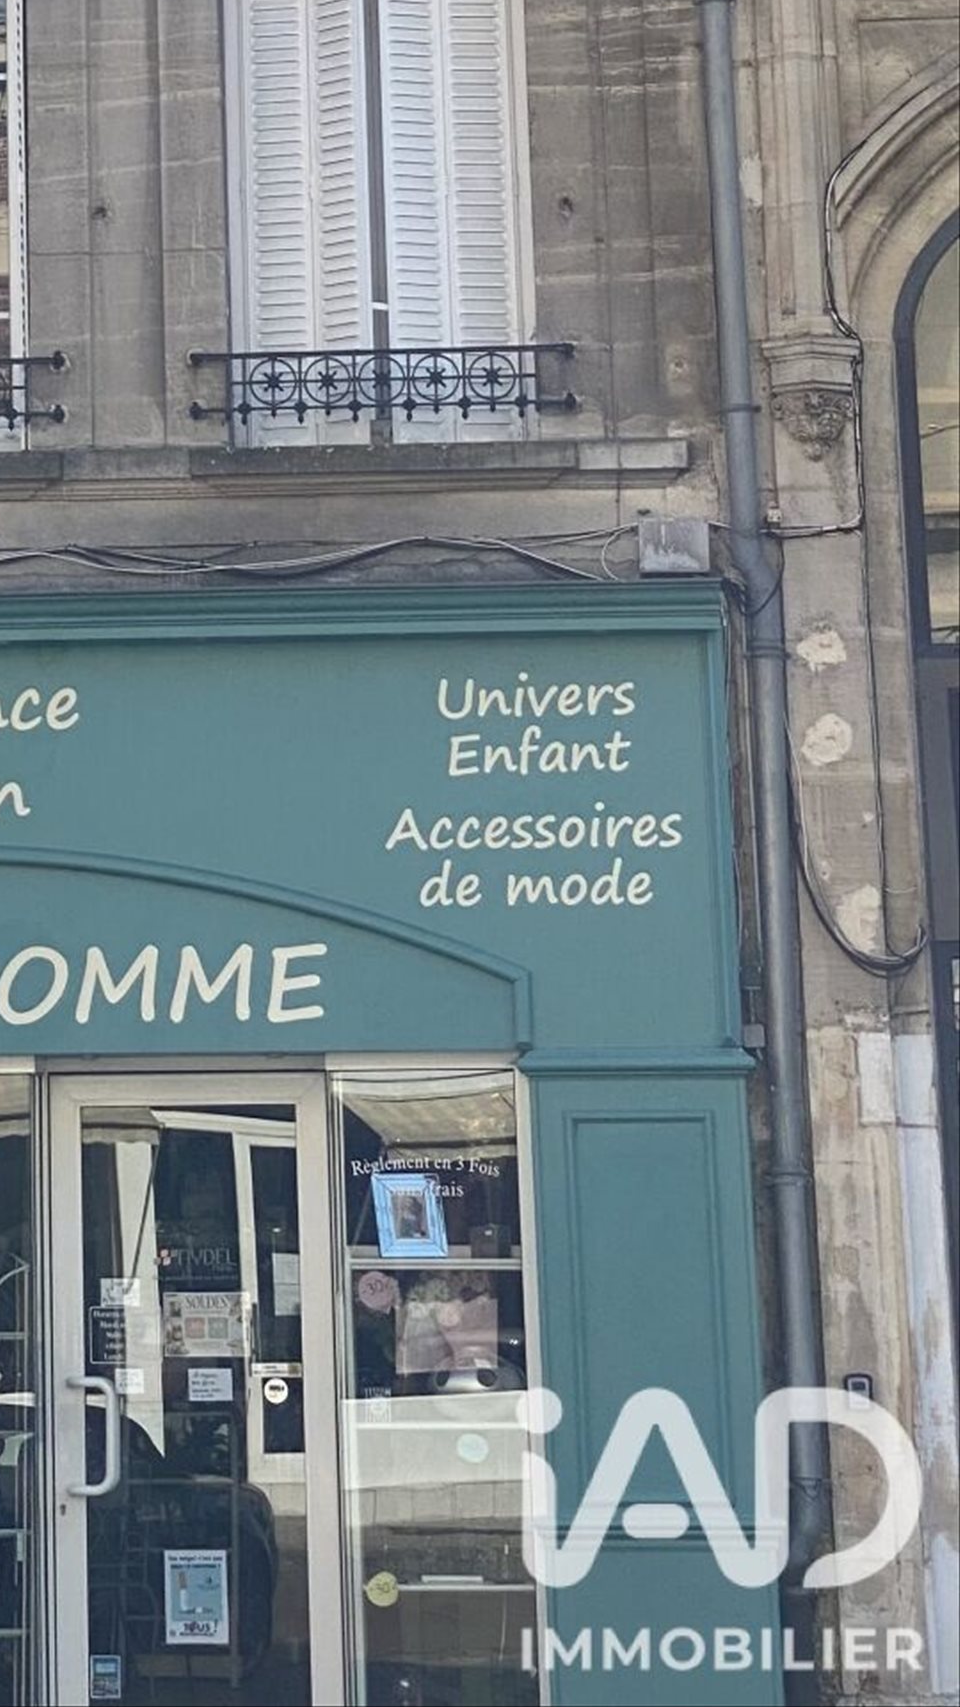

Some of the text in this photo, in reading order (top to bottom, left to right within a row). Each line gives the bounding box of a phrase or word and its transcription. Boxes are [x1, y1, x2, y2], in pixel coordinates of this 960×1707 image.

[438, 673, 636, 720] Univers
[448, 724, 632, 777] Enfant
[385, 801, 683, 851] Accessoires
[419, 857, 654, 907] de mode
[351, 1156, 501, 1178] Règlement en 3 Fois
